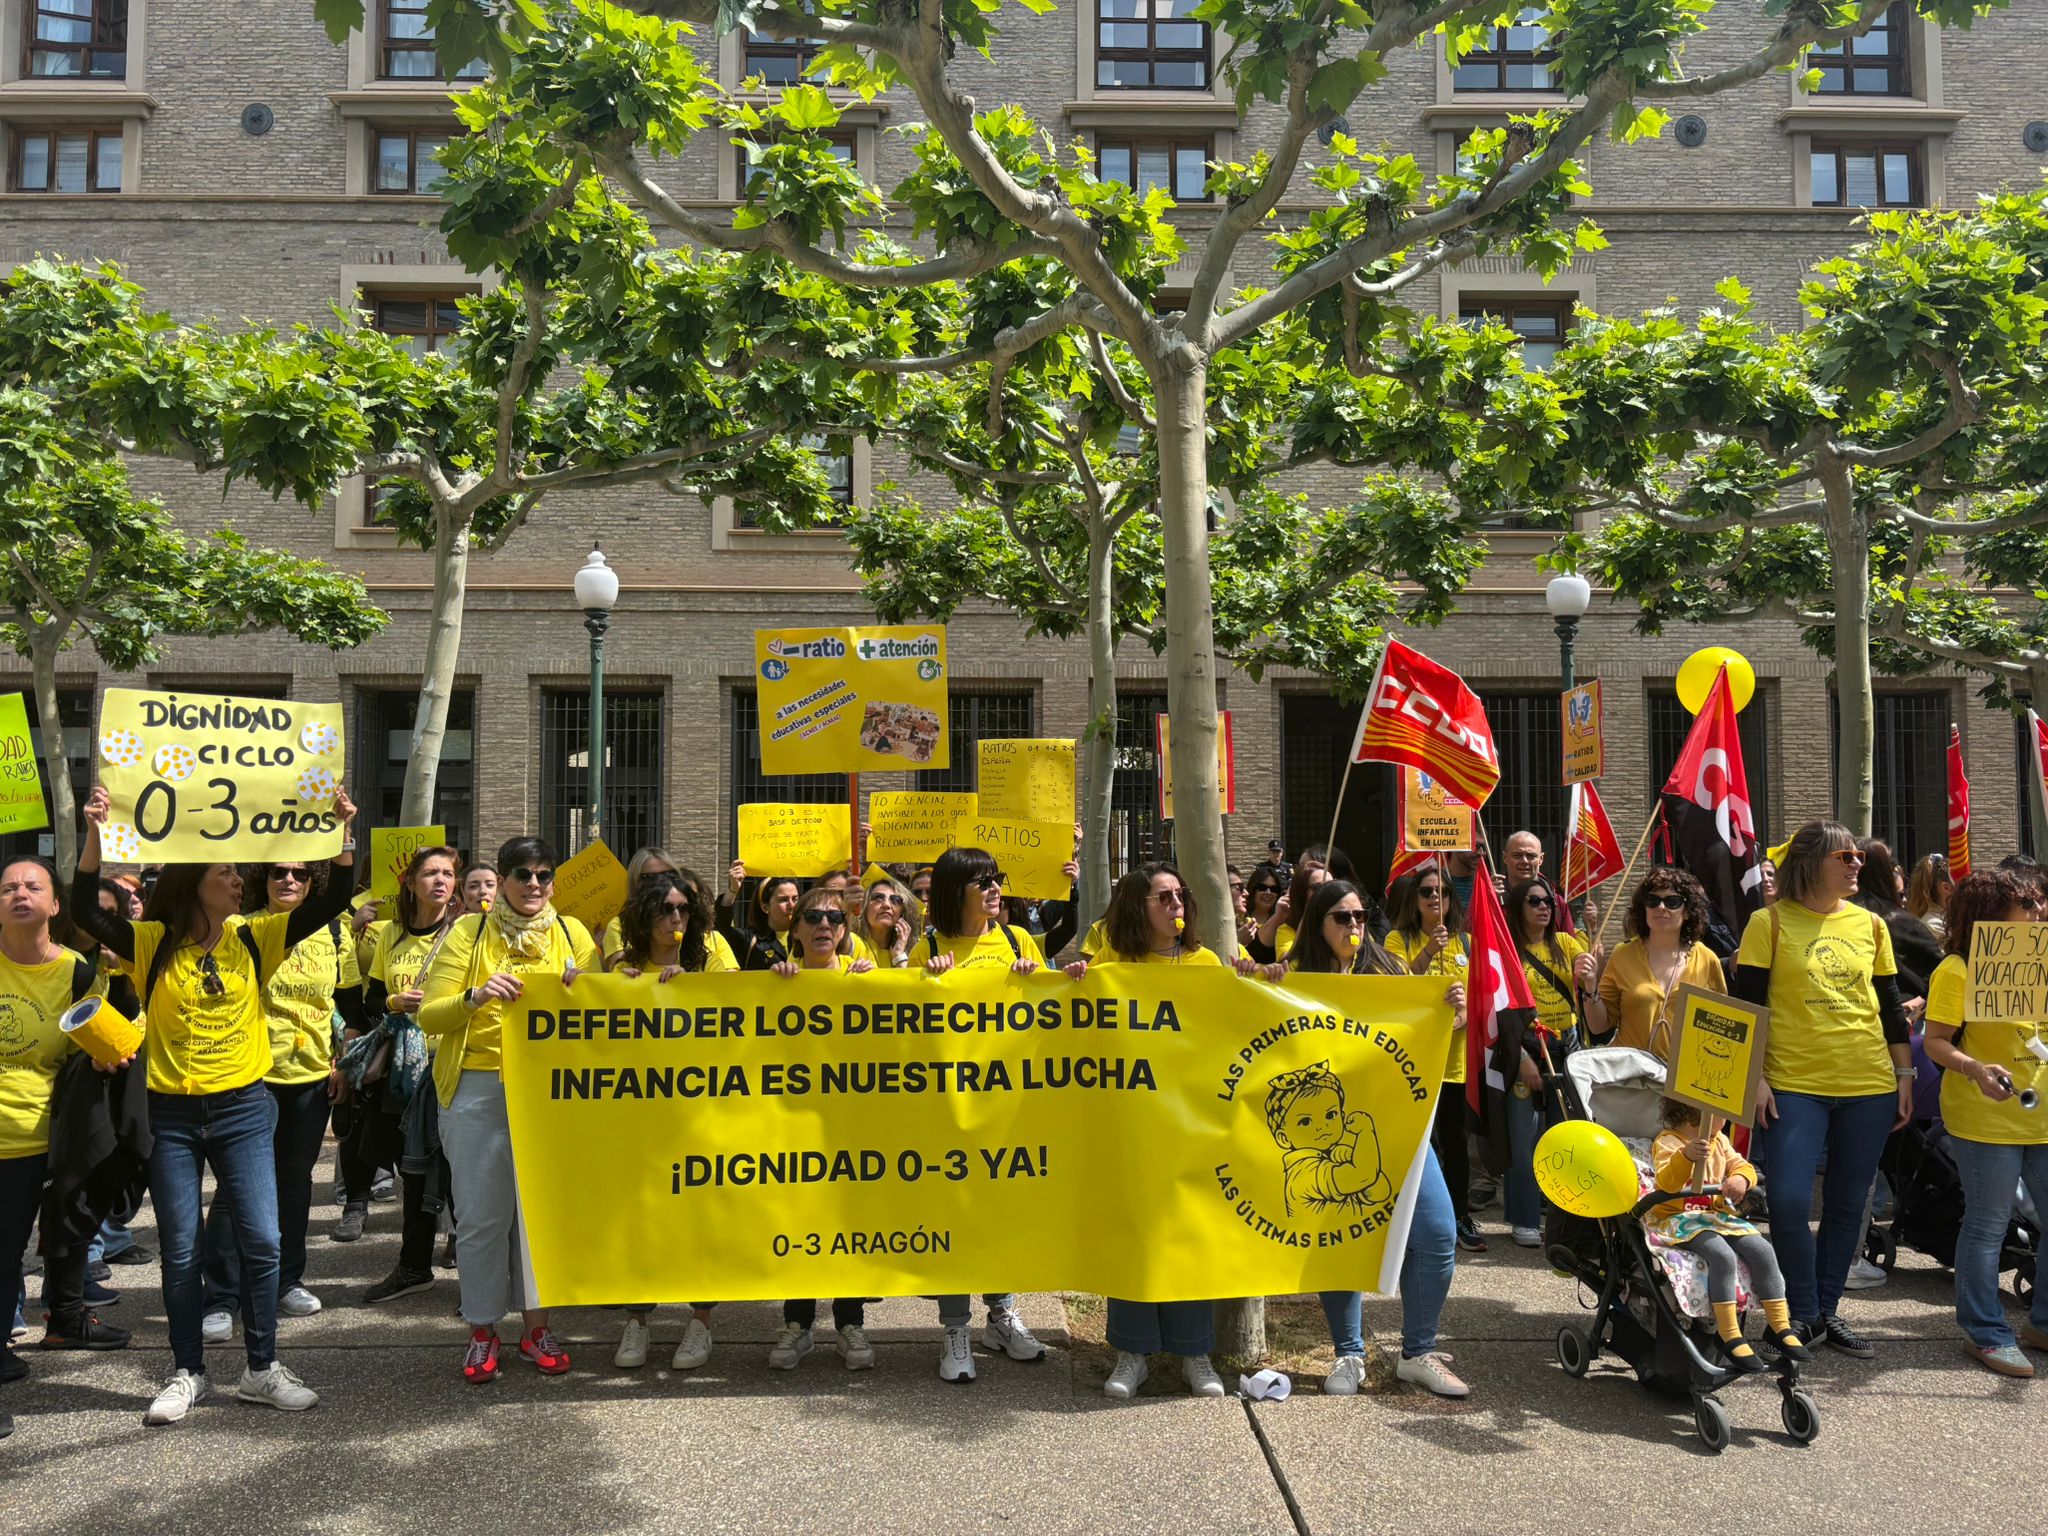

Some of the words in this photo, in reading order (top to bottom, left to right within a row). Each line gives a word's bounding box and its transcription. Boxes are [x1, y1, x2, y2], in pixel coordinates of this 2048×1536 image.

[803, 638, 845, 657] ratio
[879, 638, 937, 657] atención
[776, 711, 783, 719] a
[783, 703, 797, 715] las
[798, 680, 846, 708] necesidades
[139, 695, 292, 733] DIGNIDAD
[771, 715, 812, 740] educativas
[814, 692, 856, 718] especiales
[199, 744, 295, 767] CICLO
[983, 743, 1017, 754] RATIOS
[1574, 746, 1594, 758] RATIOS
[1575, 764, 1597, 776] CALIDAD
[250, 799, 338, 834] años
[877, 810, 914, 818] INVISIBLE
[883, 821, 933, 831] DIGNIDAD
[386, 832, 425, 853] STOP
[875, 836, 945, 849] RECONOCIMIENTO
[973, 825, 1040, 848] RATIOS
[1976, 926, 2016, 957] NOS
[1975, 990, 2034, 1017] FALTAN
[528, 1006, 745, 1041] DEFENDER
[755, 1004, 833, 1038] LOS
[842, 998, 1063, 1036] DERECHOS
[1072, 998, 1118, 1029] DE
[1128, 1000, 1182, 1032] LA
[1706, 1013, 1736, 1027] DIGNIDAD
[1217, 1063, 1245, 1102] LAS
[1239, 1014, 1336, 1064] PRIMERAS
[1342, 1018, 1370, 1039] EN
[1373, 1031, 1428, 1102] EDUCAR
[551, 1065, 750, 1100] INFANCIA
[761, 1063, 811, 1096] ES
[820, 1060, 1012, 1094] NUESTRA
[1022, 1056, 1157, 1091] LUCHA
[671, 1149, 886, 1195] ¡DIGNIDAD
[897, 1149, 969, 1182] 0-3
[979, 1145, 1049, 1180] YA!
[1215, 1163, 1240, 1201] LAS
[1236, 1200, 1311, 1248] ÚLTIMAS
[1318, 1229, 1343, 1248] EN
[772, 1233, 822, 1257] 0-3
[830, 1225, 951, 1256] ARAGÓN
